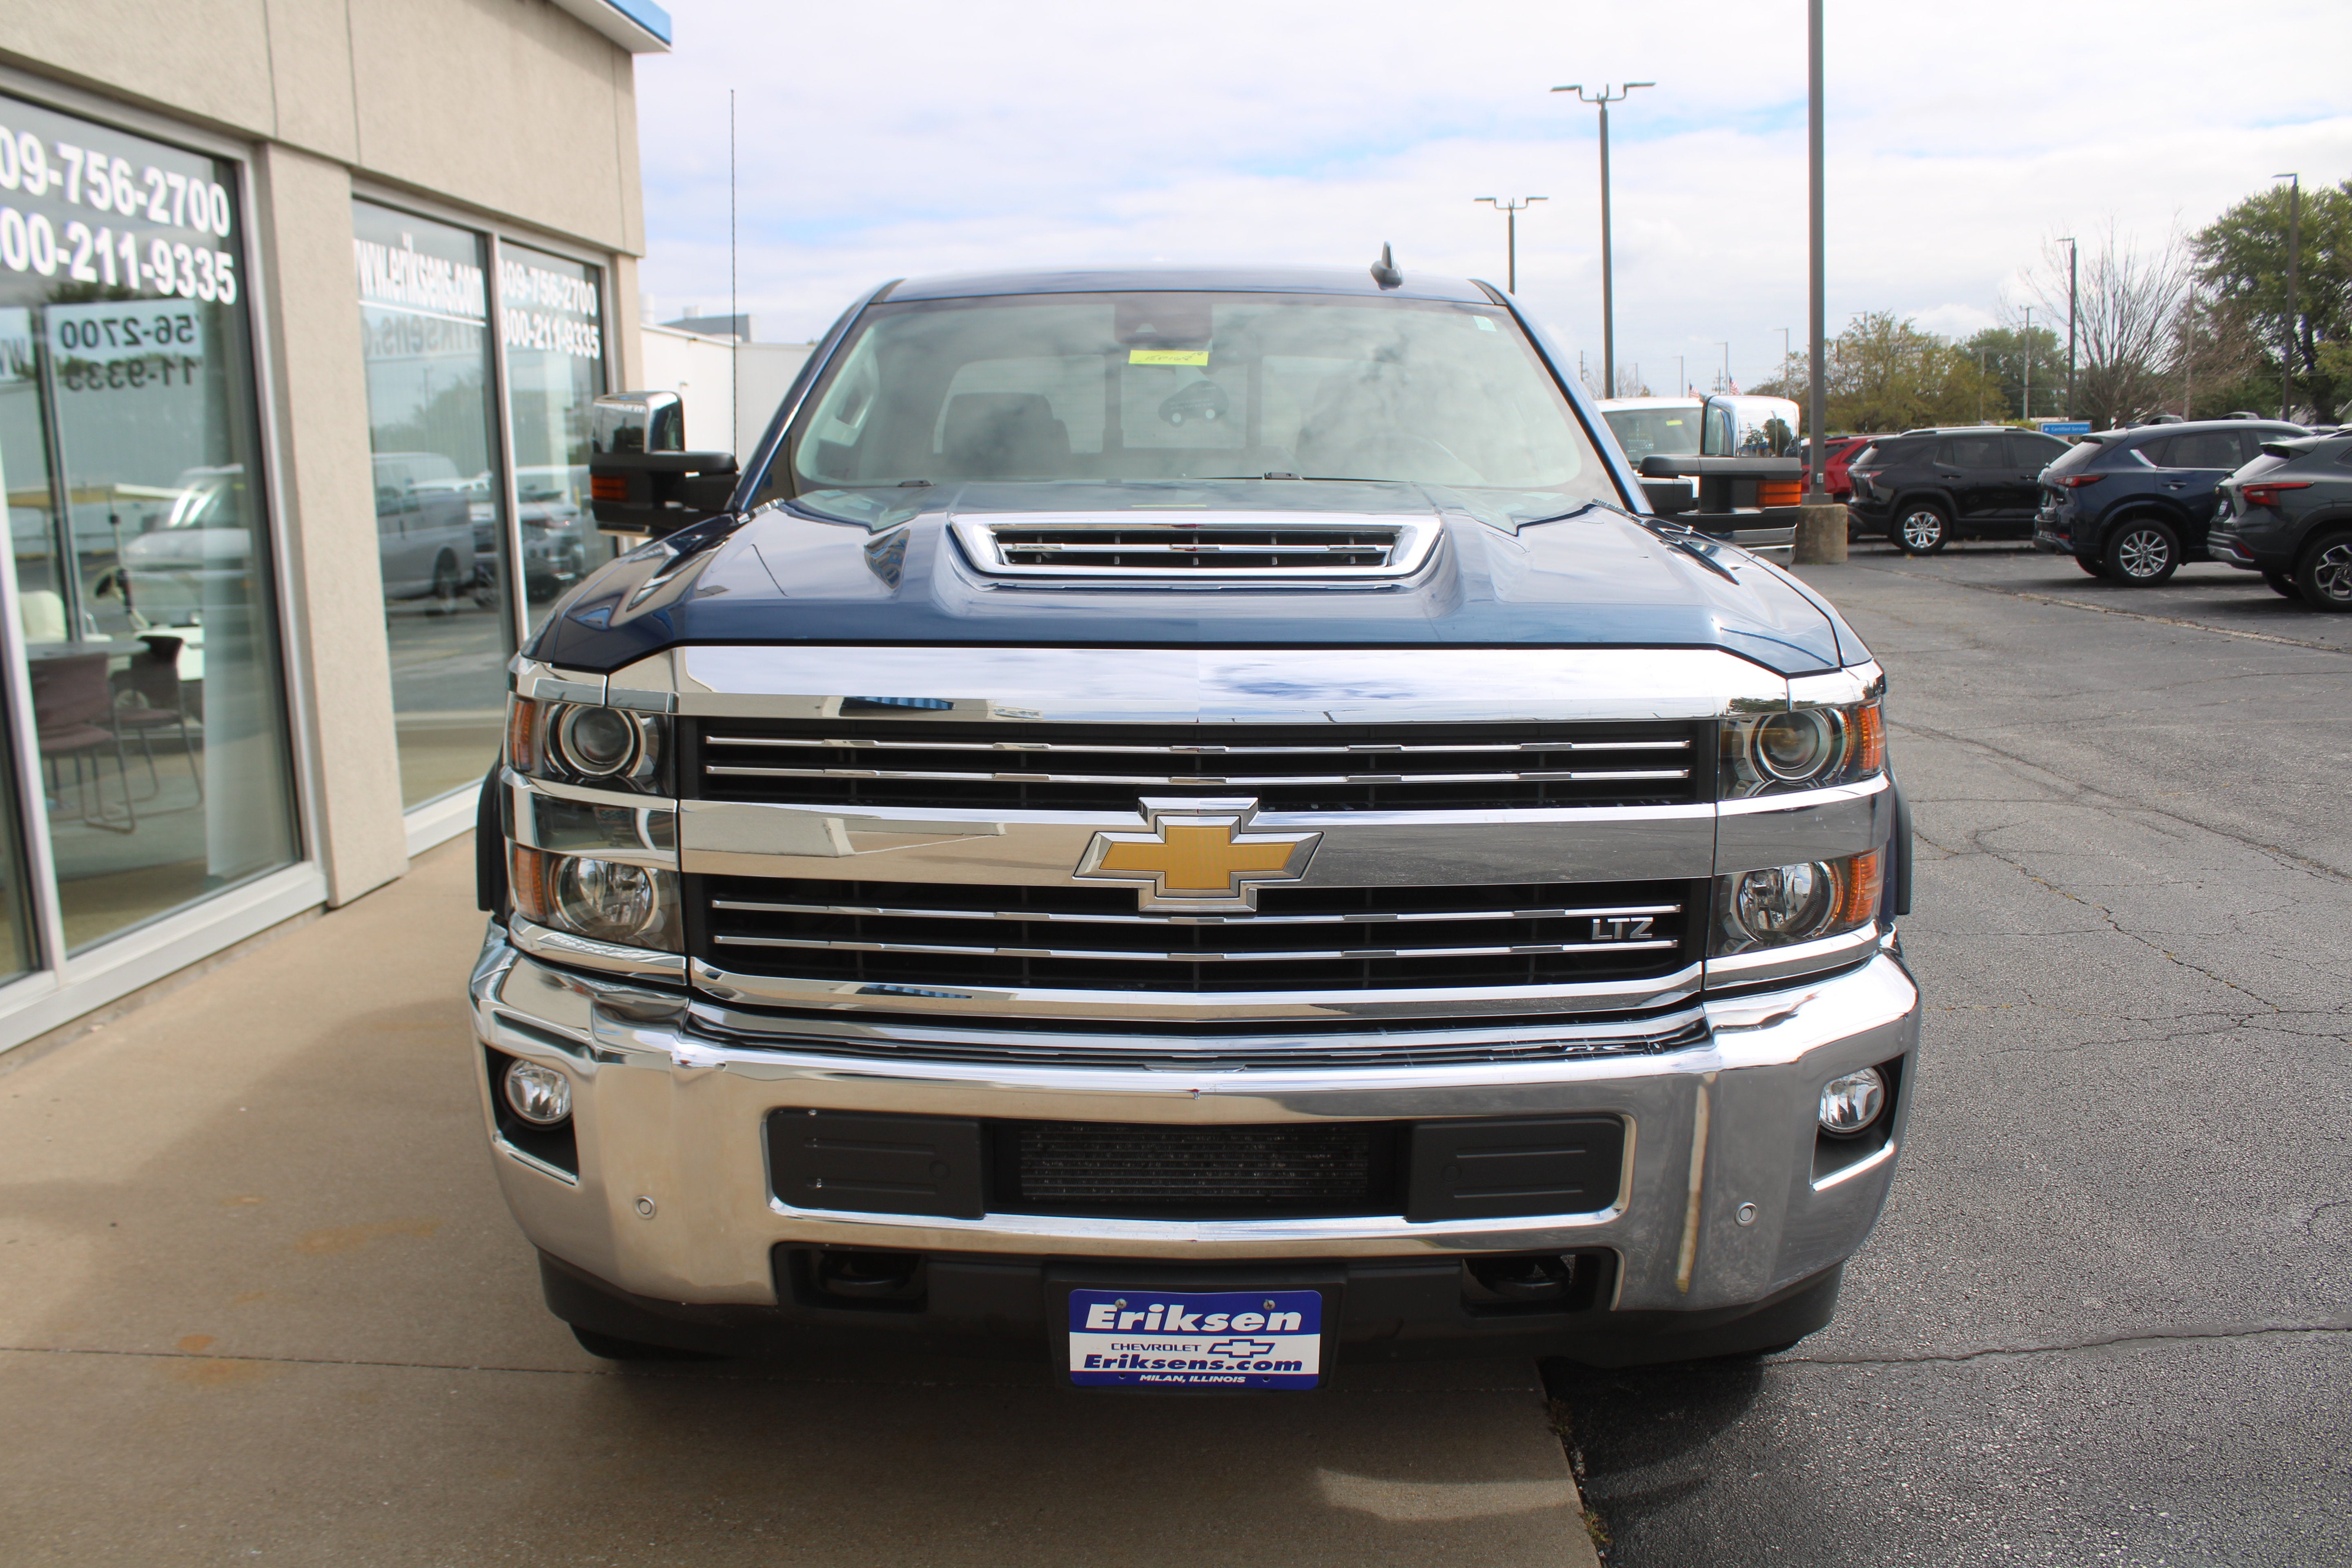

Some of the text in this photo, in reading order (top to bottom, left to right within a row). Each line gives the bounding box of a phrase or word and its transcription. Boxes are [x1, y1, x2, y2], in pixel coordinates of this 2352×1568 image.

[0, 206, 237, 305] 00-211-9335
[1592, 917, 1653, 940] LTZ
[1085, 1303, 1302, 1332] Eriksen
[1111, 1343, 1201, 1352] CHEVROLET
[1084, 1354, 1303, 1371] Eriksens.com
[1139, 1374, 1186, 1383] MILAN,
